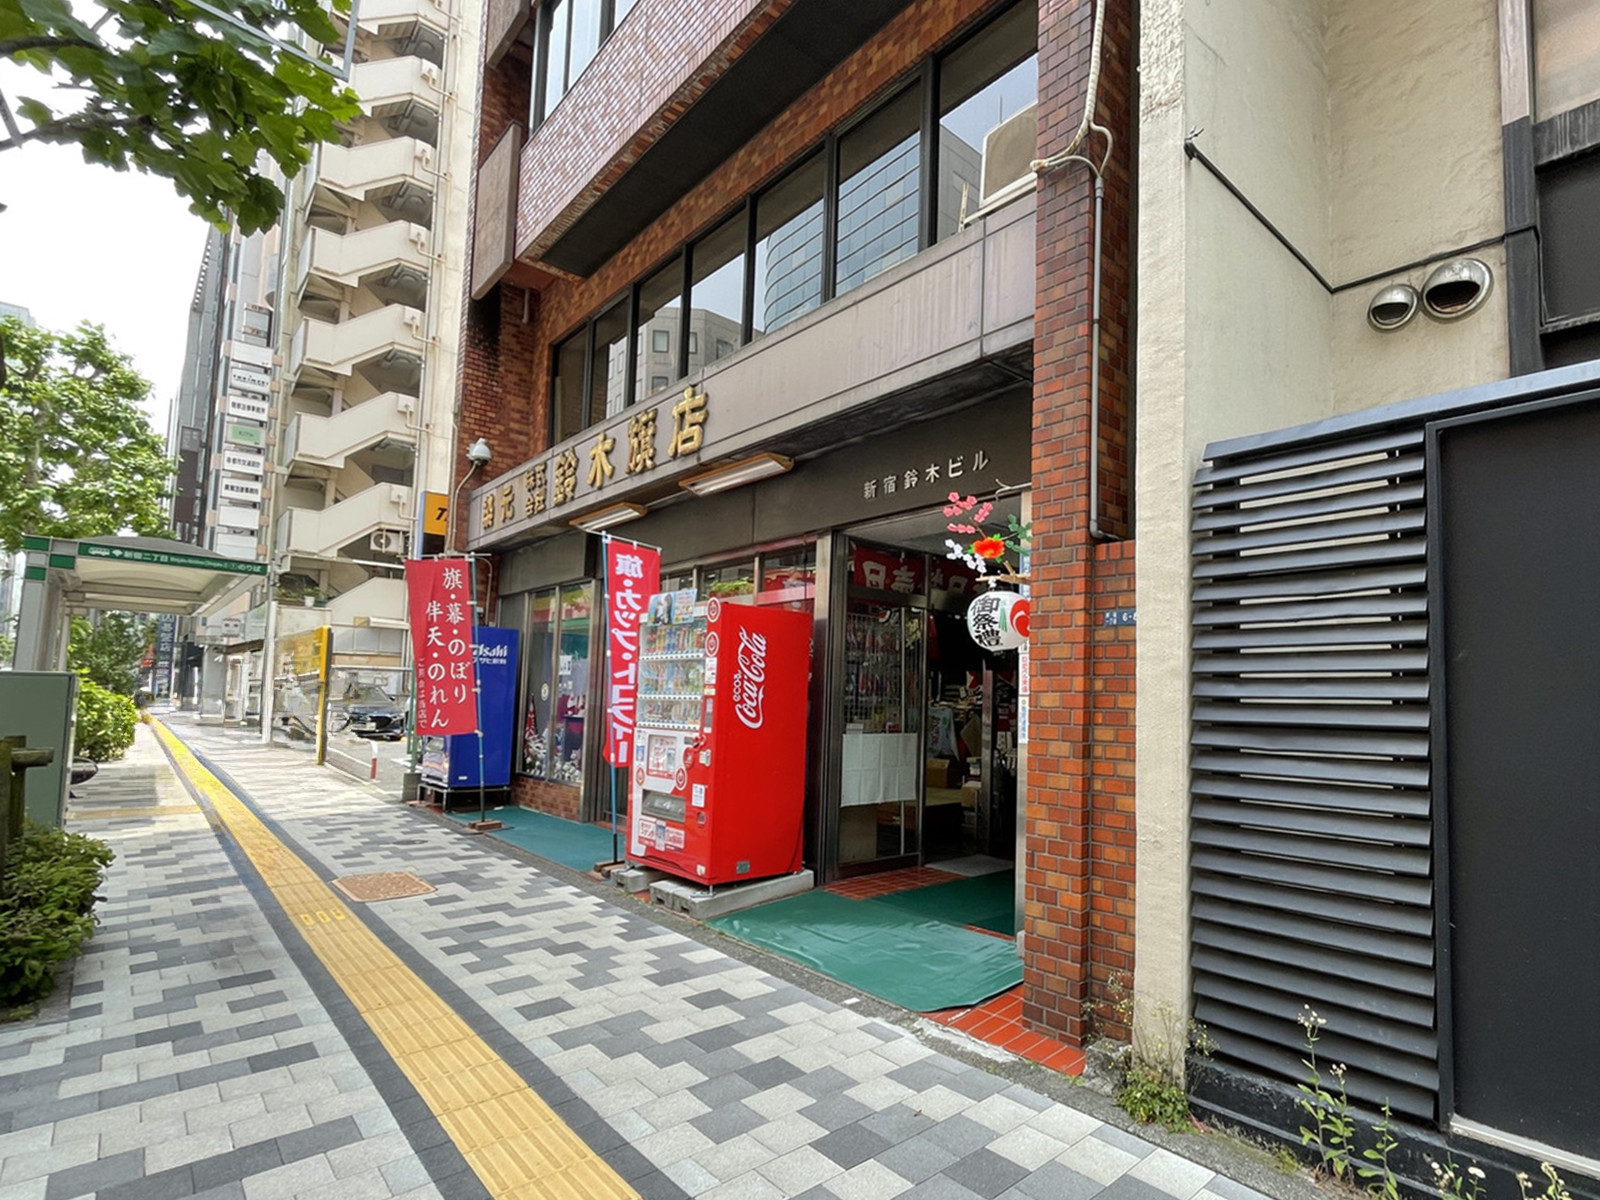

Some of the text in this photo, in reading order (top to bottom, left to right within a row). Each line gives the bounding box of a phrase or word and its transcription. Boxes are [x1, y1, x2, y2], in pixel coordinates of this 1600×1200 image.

[863, 450, 989, 499] 新宿鈴木ビル
[436, 507, 447, 522] T
[425, 600, 449, 729] 伴天・のれん
[442, 567, 470, 704] 旗・幕・のぼり
[472, 643, 508, 657] Asahi
[734, 625, 767, 729] Coca-Cola
